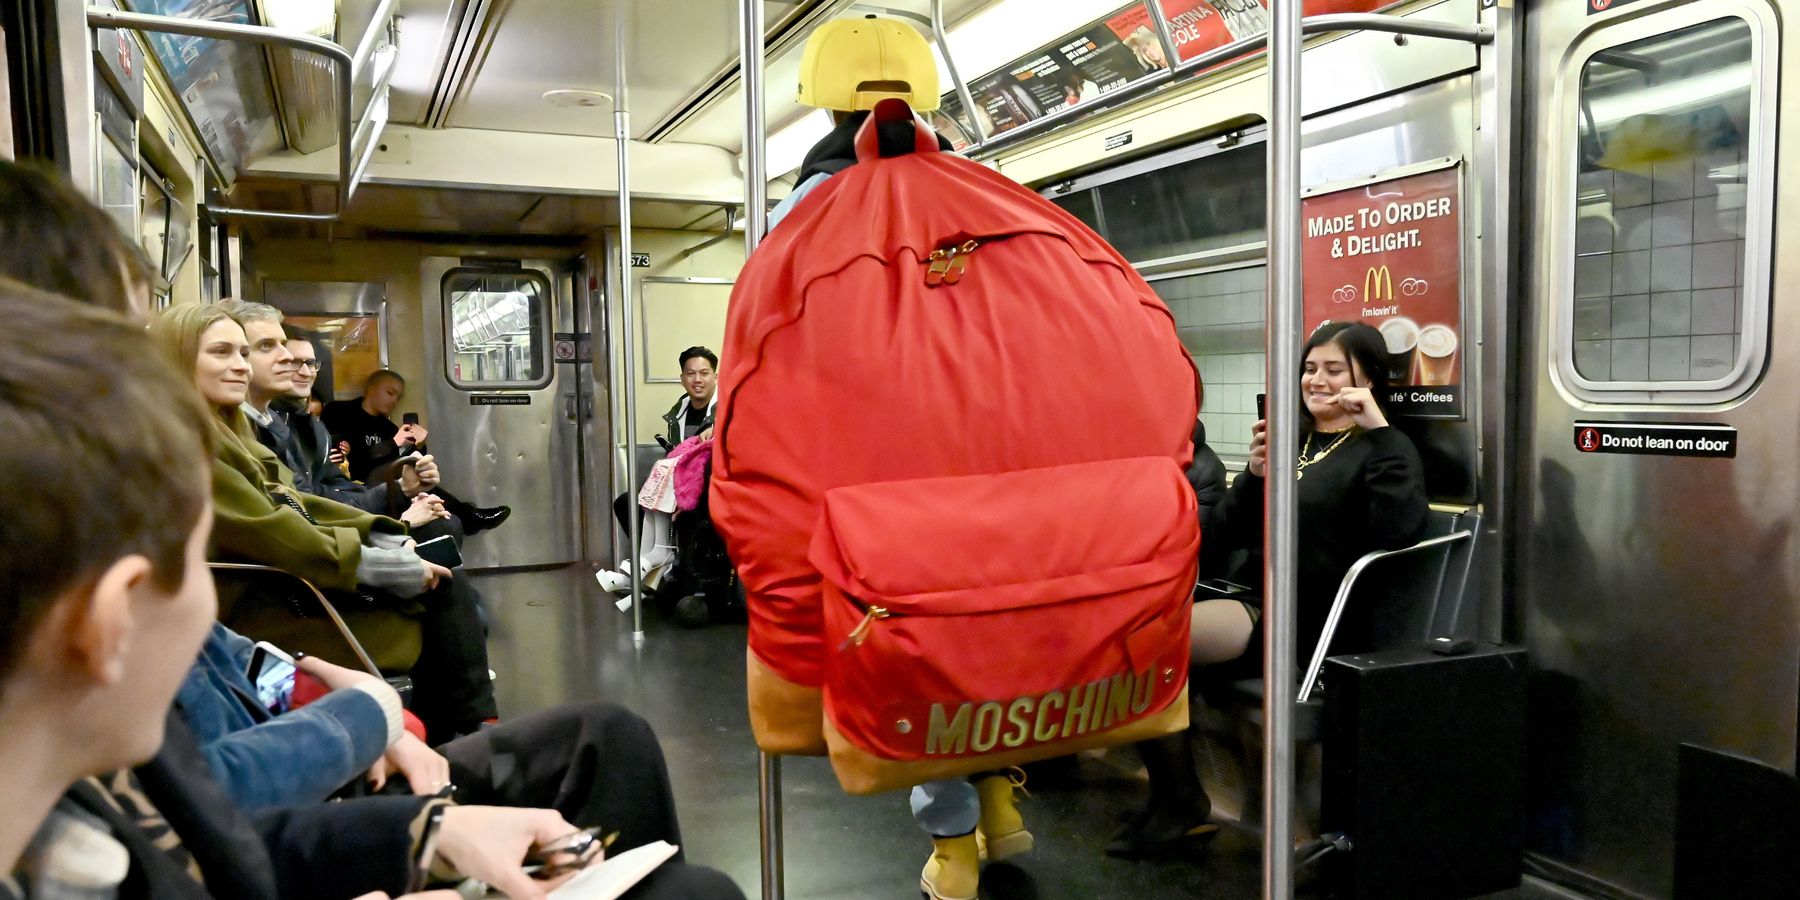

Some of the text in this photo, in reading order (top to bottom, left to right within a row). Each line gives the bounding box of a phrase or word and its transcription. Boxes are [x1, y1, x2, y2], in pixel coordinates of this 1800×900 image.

[1167, 6, 1213, 31] ARTINA
[1308, 214, 1355, 238] MADE
[1385, 197, 1451, 225] ORDER
[1331, 229, 1421, 258] & DELIGHT.
[631, 255, 650, 266] 573
[1388, 392, 1453, 402] afé Coffees
[1602, 434, 1729, 451] Do not lean on door
[925, 665, 1157, 754] MOSCHINO
